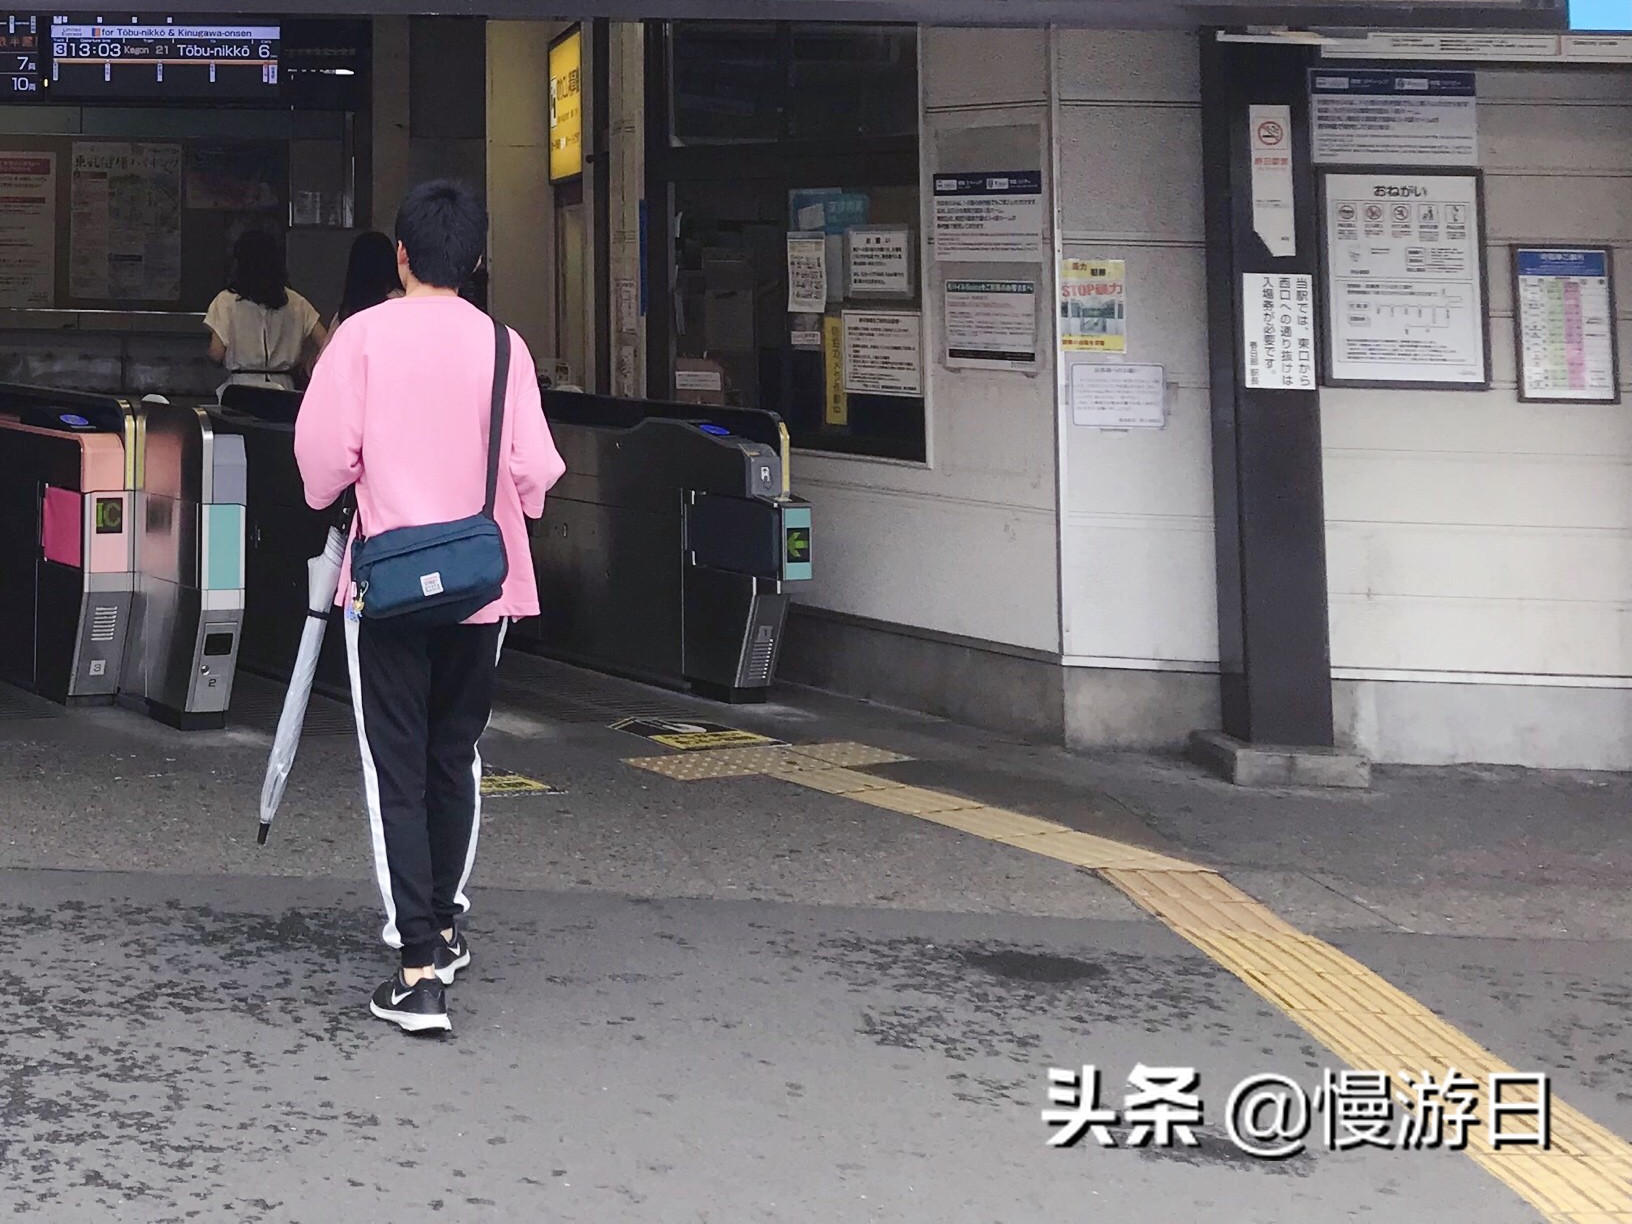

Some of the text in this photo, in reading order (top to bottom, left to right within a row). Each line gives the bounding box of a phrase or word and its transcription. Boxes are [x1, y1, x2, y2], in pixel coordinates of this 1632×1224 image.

[178, 29, 252, 38] Kinugawa-onsen
[56, 45, 65, 55] 3
[70, 44, 121, 56] 13:03
[156, 45, 168, 55] 21
[259, 45, 270, 58] 6
[1373, 184, 1428, 197] おねがい
[1279, 277, 1294, 386] 西口への通り抜けは
[1296, 277, 1311, 387] 当駅では、東口から
[96, 498, 121, 528] IC
[92, 663, 102, 672] 3
[208, 678, 217, 687] 2
